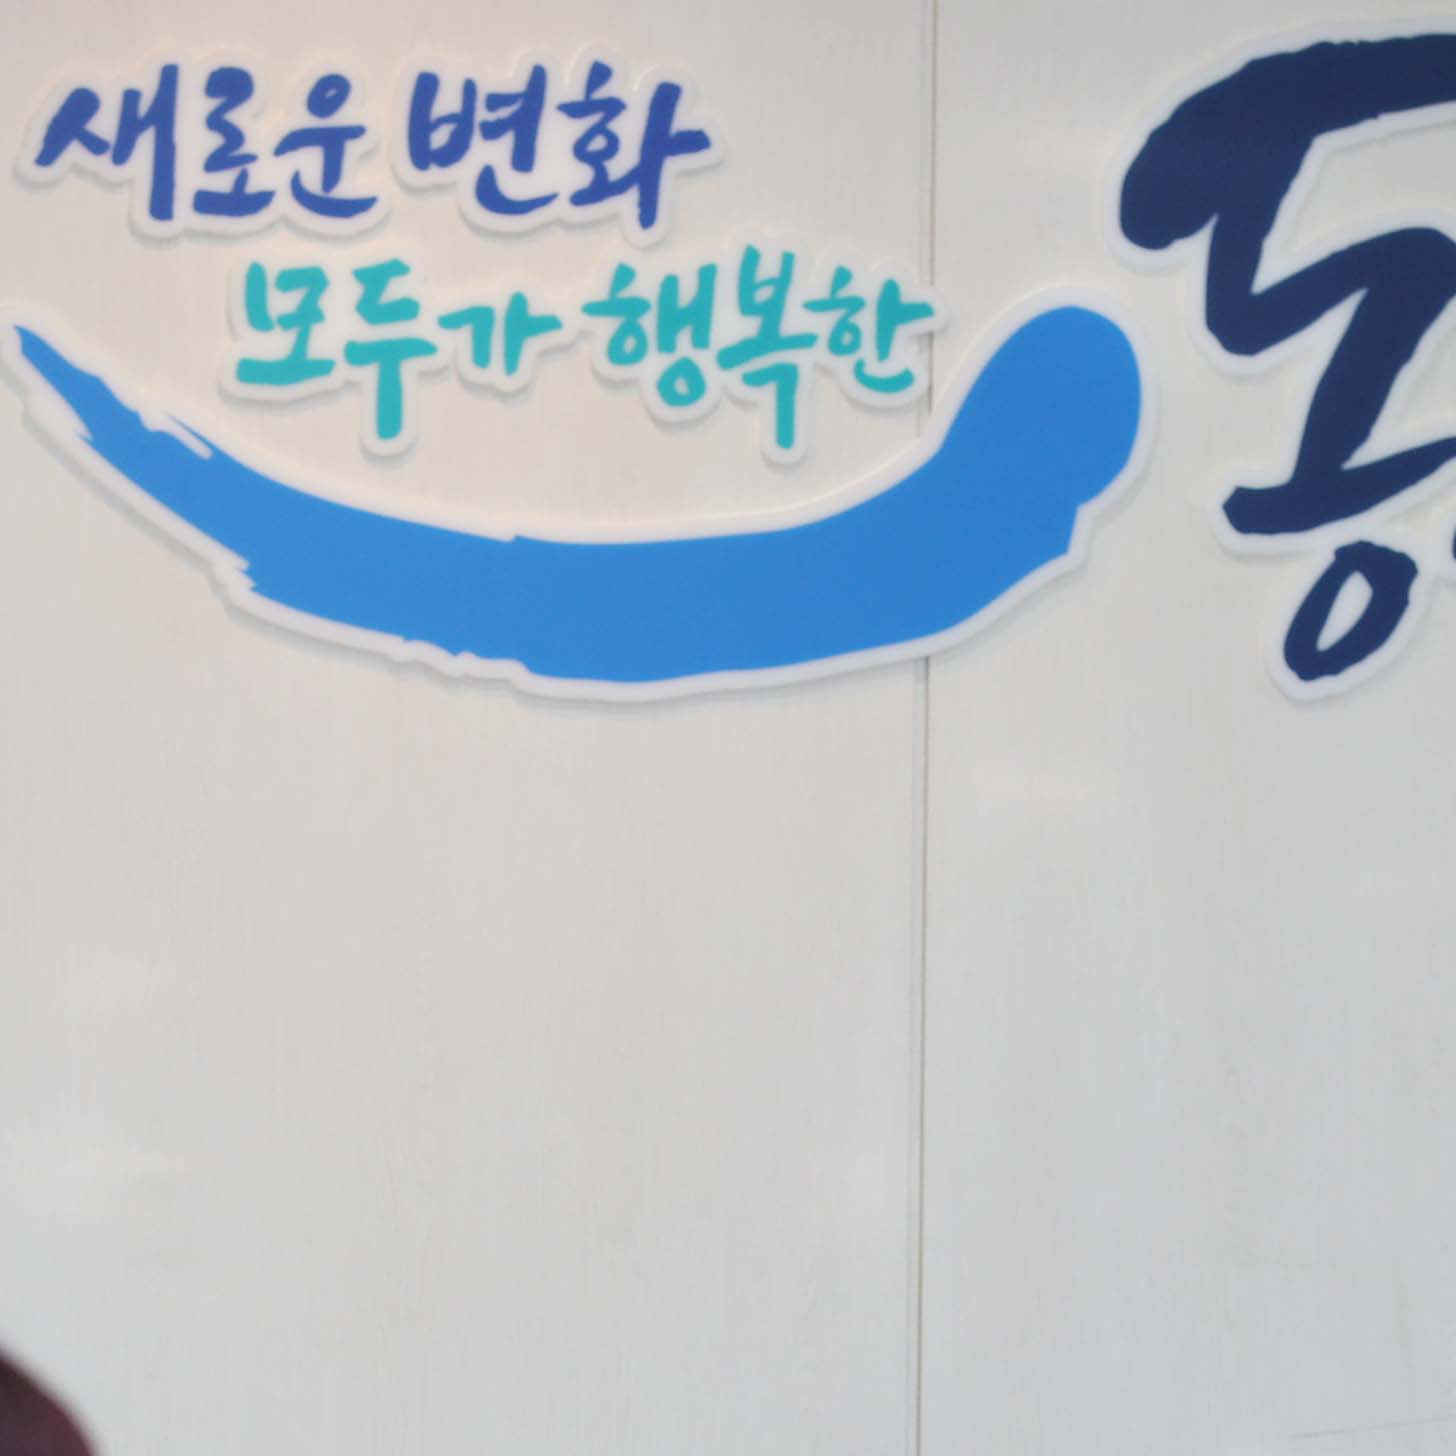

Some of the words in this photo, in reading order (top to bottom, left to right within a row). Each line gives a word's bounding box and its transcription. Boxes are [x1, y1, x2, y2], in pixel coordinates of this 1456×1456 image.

[35, 63, 378, 221] 새로운
[407, 60, 711, 229] 변화
[235, 258, 563, 440] 모두가
[581, 246, 935, 449] 행복한
